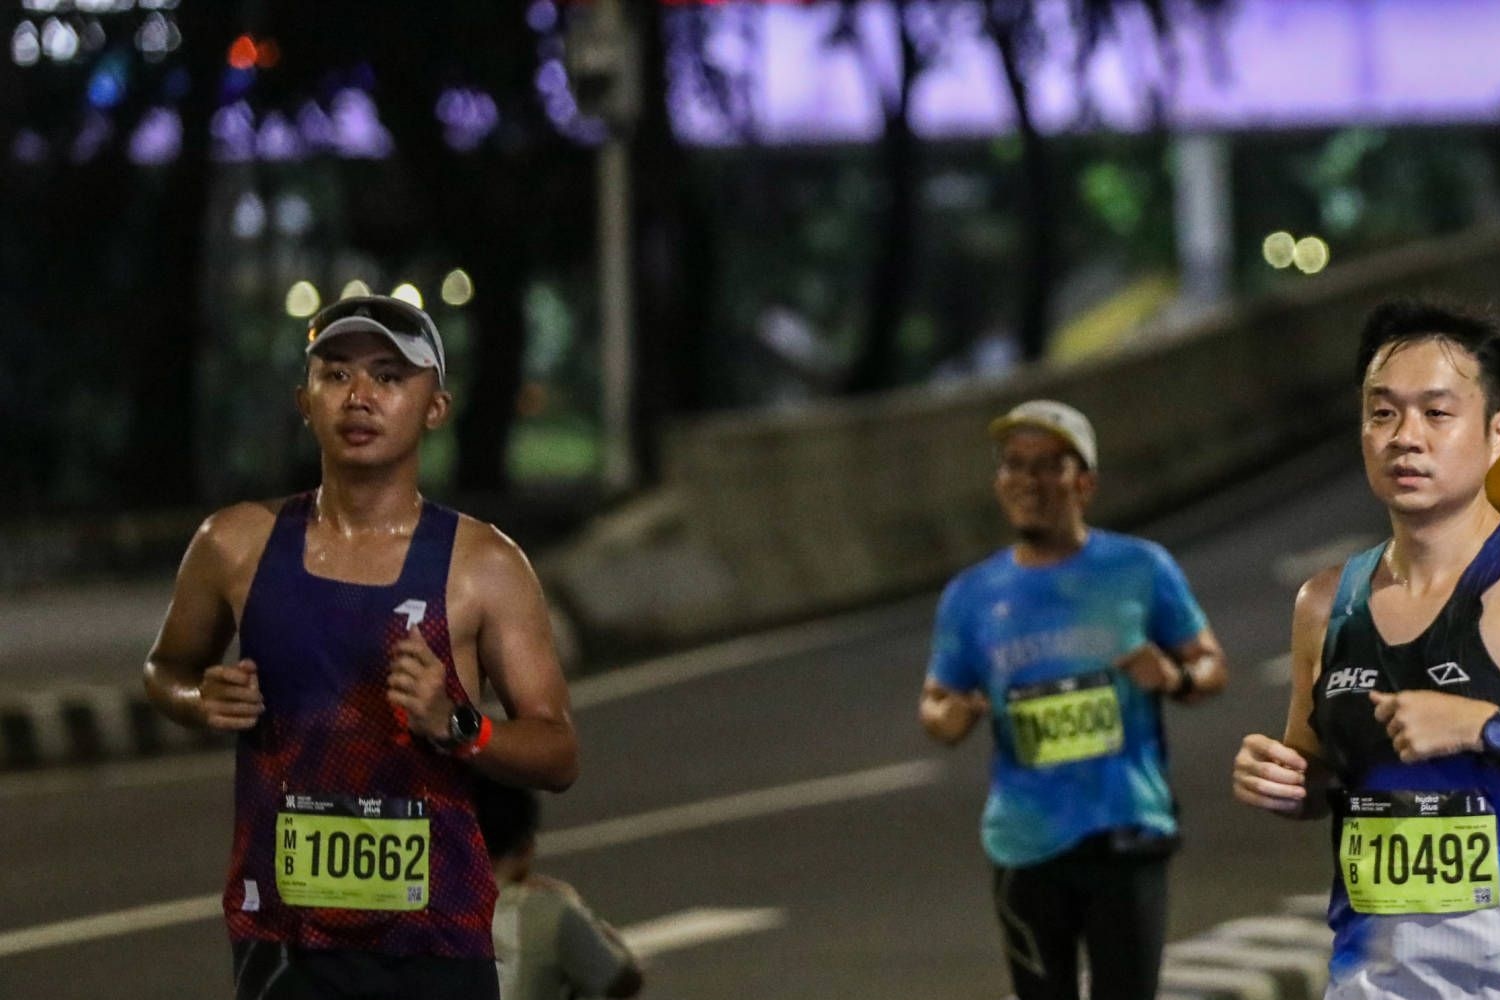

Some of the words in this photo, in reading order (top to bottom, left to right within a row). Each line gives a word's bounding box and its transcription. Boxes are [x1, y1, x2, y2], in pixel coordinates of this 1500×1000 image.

[284, 830, 297, 850] M
[1348, 834, 1362, 856] M
[284, 855, 294, 876] B
[305, 830, 426, 882] 10662
[1369, 831, 1493, 885] 10492
[1349, 862, 1358, 884] B
